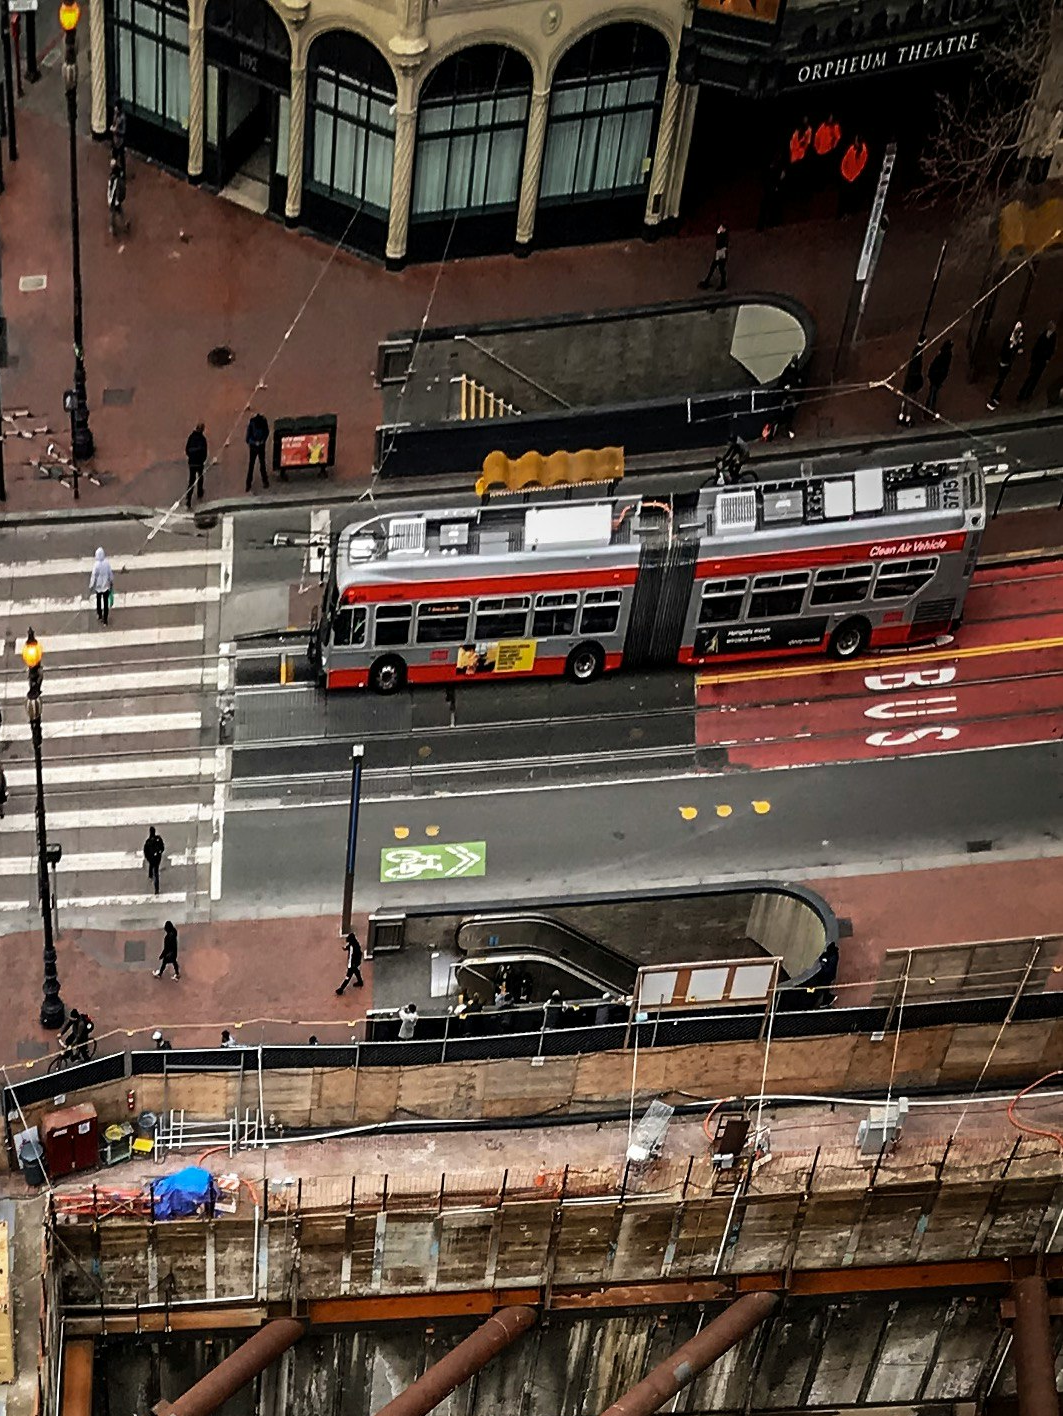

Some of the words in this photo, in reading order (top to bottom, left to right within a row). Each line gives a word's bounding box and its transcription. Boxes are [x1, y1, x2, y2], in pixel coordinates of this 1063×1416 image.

[797, 51, 887, 83] ORPHEUM
[897, 31, 980, 64] THEATRE
[870, 546, 897, 557] Clean
[896, 542, 912, 554] Air
[912, 539, 947, 552] Vehicle
[864, 666, 960, 747] BUS
